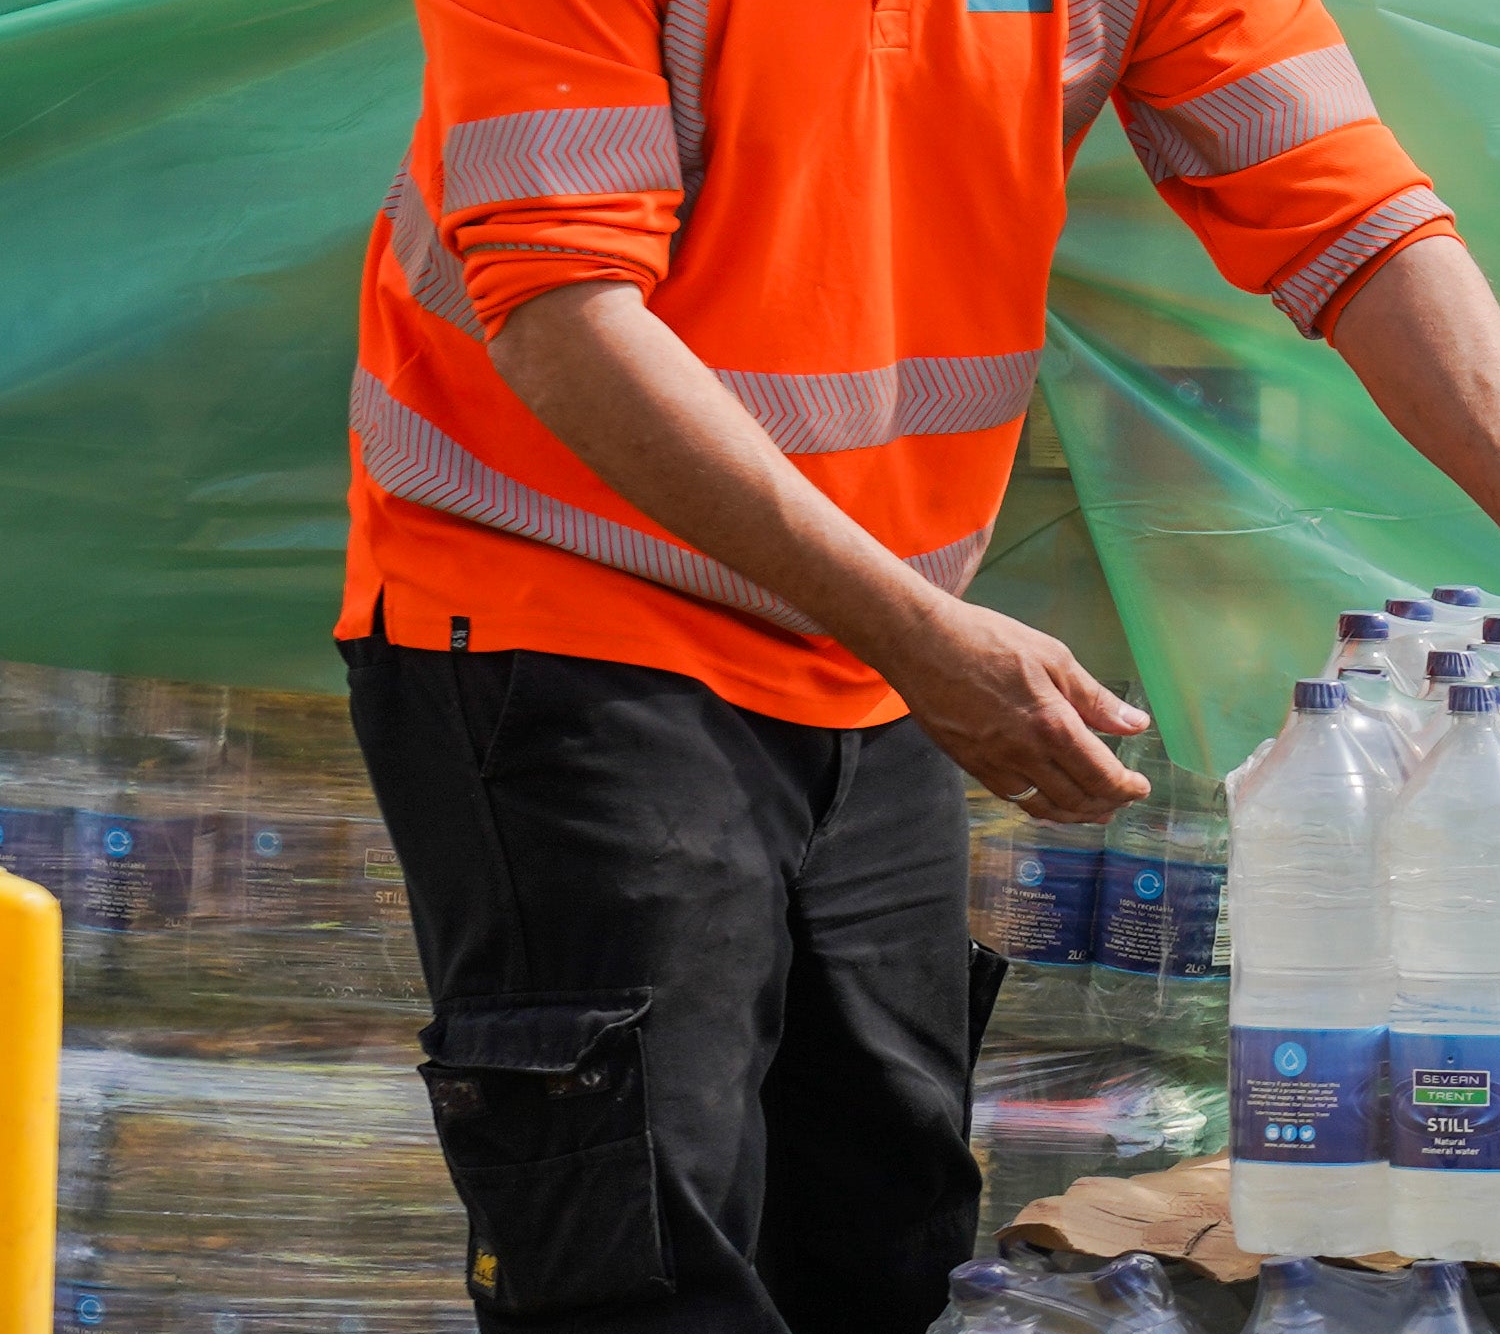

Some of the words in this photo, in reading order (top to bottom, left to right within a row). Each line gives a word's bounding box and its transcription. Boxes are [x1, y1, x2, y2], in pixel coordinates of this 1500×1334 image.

[1422, 1074, 1480, 1085] SEVERN
[1427, 1091, 1475, 1101] TRENT
[1427, 1117, 1474, 1133] STILL
[1434, 1137, 1466, 1146] Natural
[1421, 1147, 1453, 1155] mineral
[1455, 1148, 1480, 1156] water
